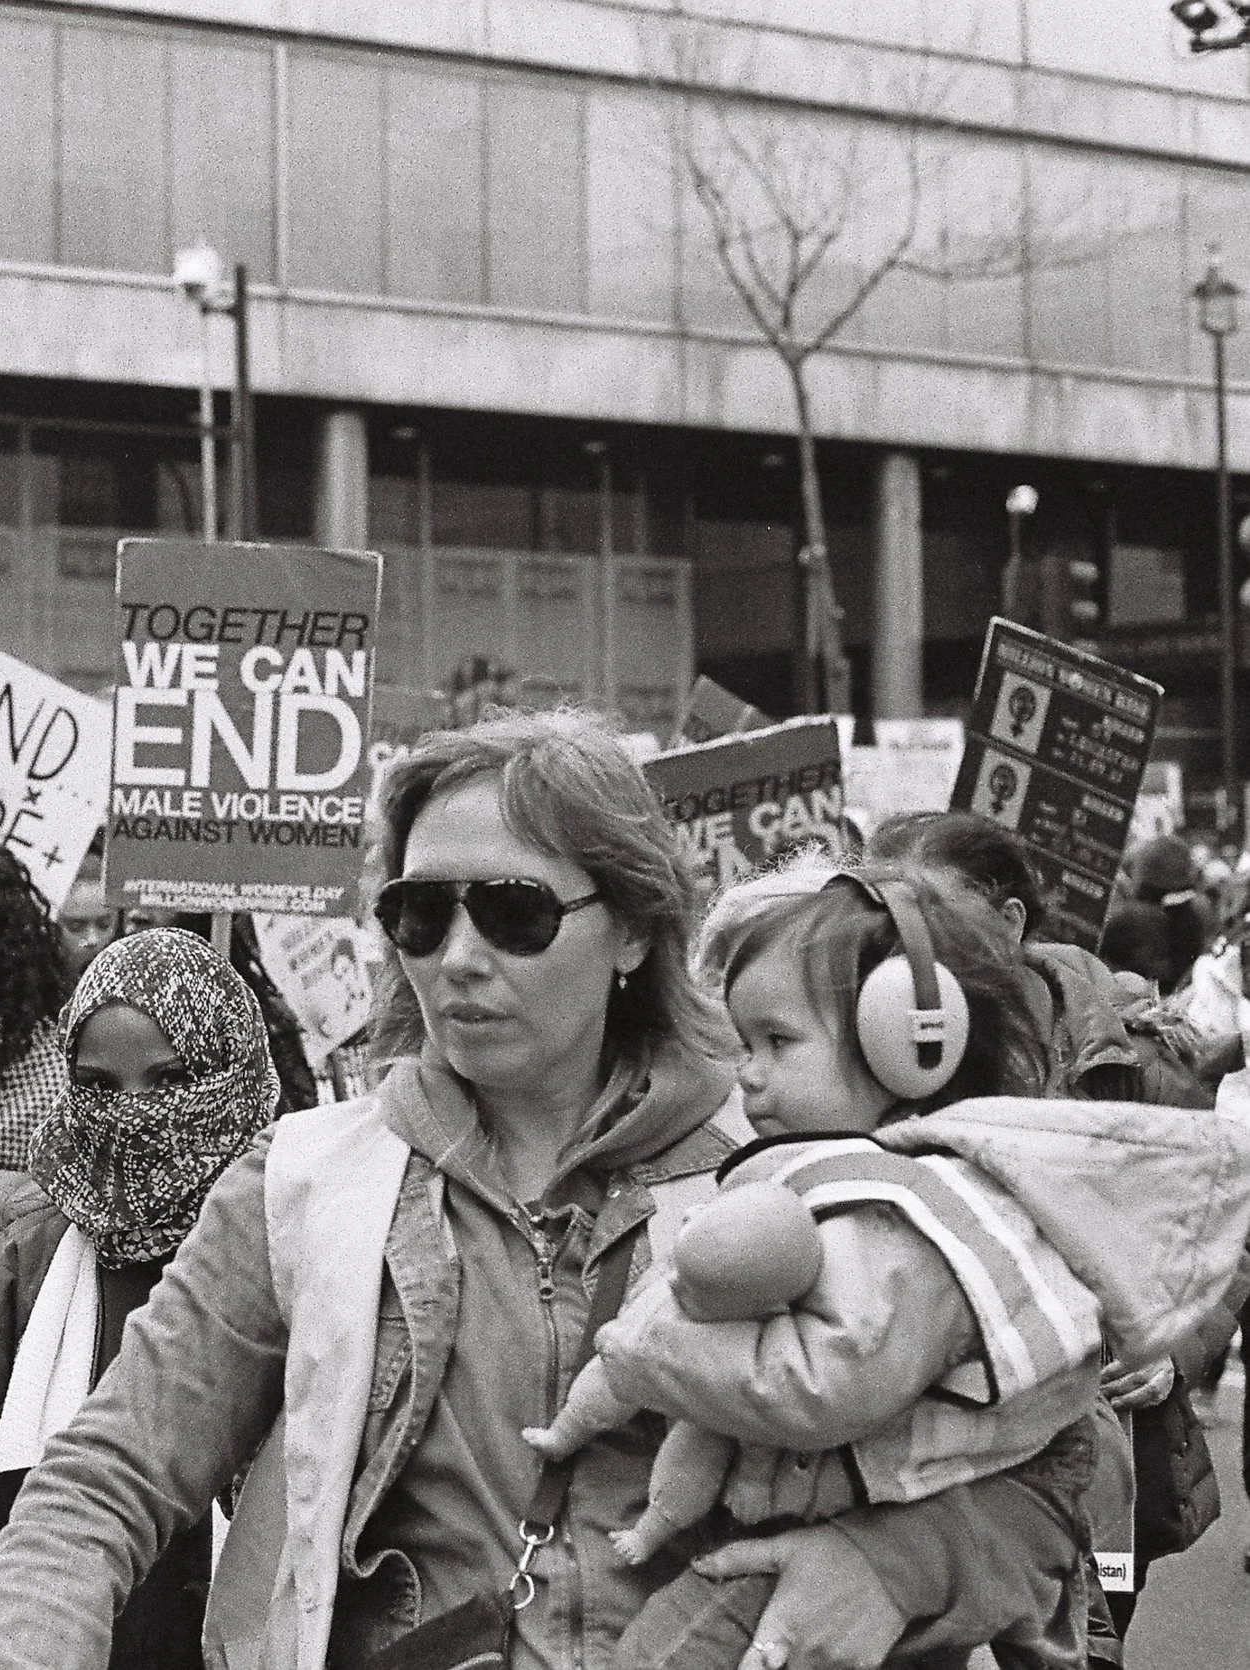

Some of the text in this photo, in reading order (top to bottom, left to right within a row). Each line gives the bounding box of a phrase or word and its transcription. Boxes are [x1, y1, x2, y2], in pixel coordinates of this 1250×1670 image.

[121, 602, 370, 648] TOGETHER
[121, 640, 367, 698] WE CAN
[113, 685, 364, 793] END
[111, 788, 364, 824] MALE VIOLENCE
[749, 784, 843, 839] CAN
[111, 817, 360, 848] AGAINST WOMEN
[313, 885, 345, 900] DAY
